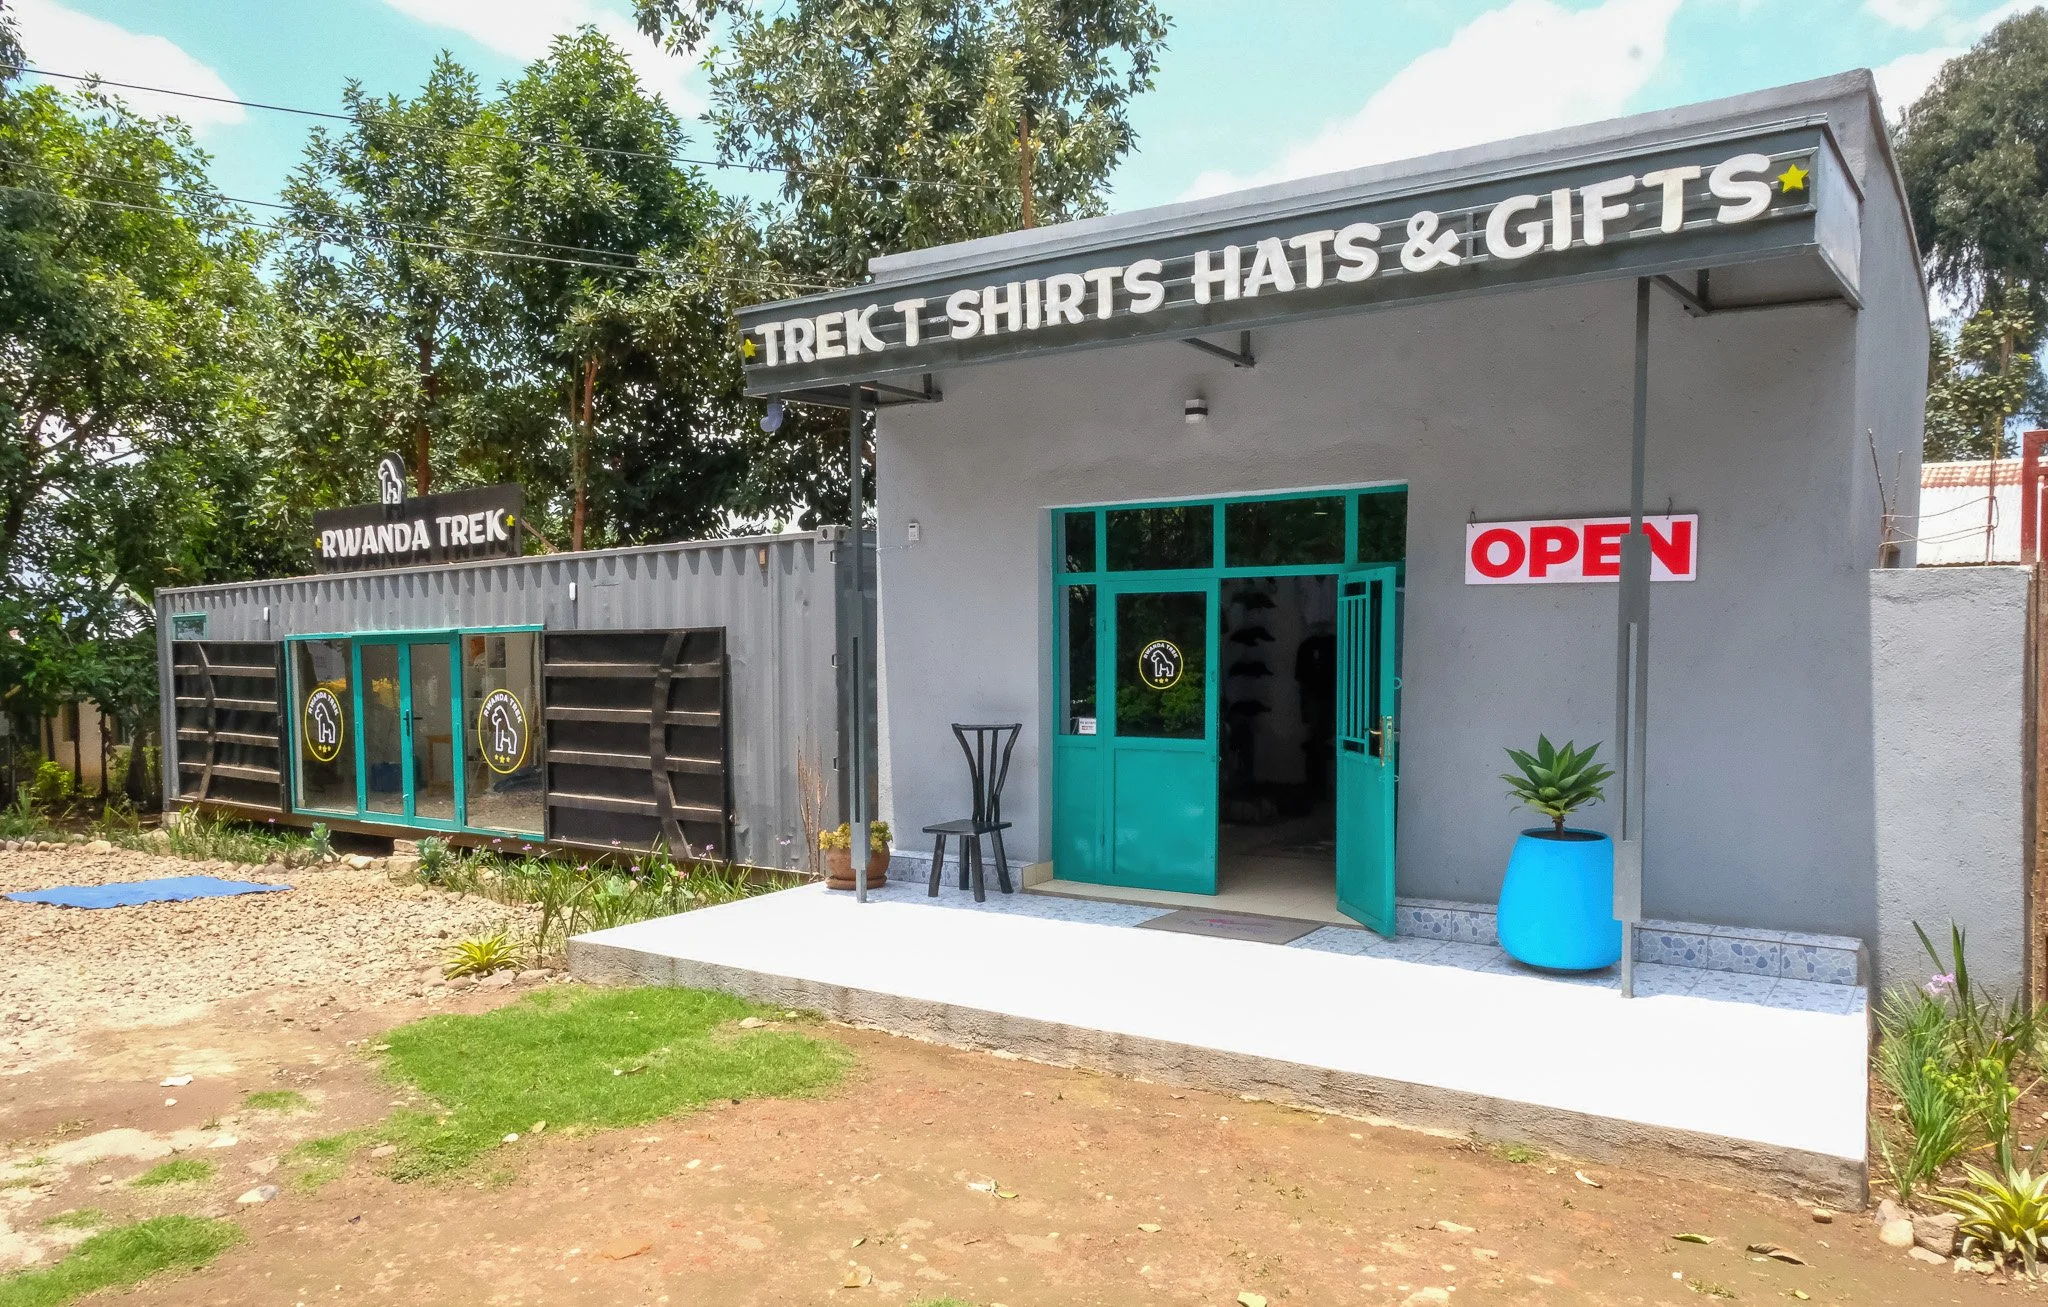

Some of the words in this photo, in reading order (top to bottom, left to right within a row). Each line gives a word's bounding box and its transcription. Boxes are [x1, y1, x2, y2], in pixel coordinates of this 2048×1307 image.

[755, 304, 887, 367] TREK
[894, 298, 926, 347] T
[946, 259, 1165, 340] SHIRTS
[1191, 222, 1382, 304] HATS
[1400, 210, 1461, 273] &
[1485, 153, 1772, 260] GIFTS
[321, 519, 430, 558] RWANDA
[436, 508, 508, 547] TREK
[1471, 521, 1692, 578] OPEN
[1143, 643, 1165, 659] RWANDA
[1166, 644, 1179, 659] TREK
[308, 691, 327, 714] RWANDA
[327, 694, 339, 716] TREK
[483, 693, 508, 717] RWANDA
[509, 697, 522, 723] TREK
